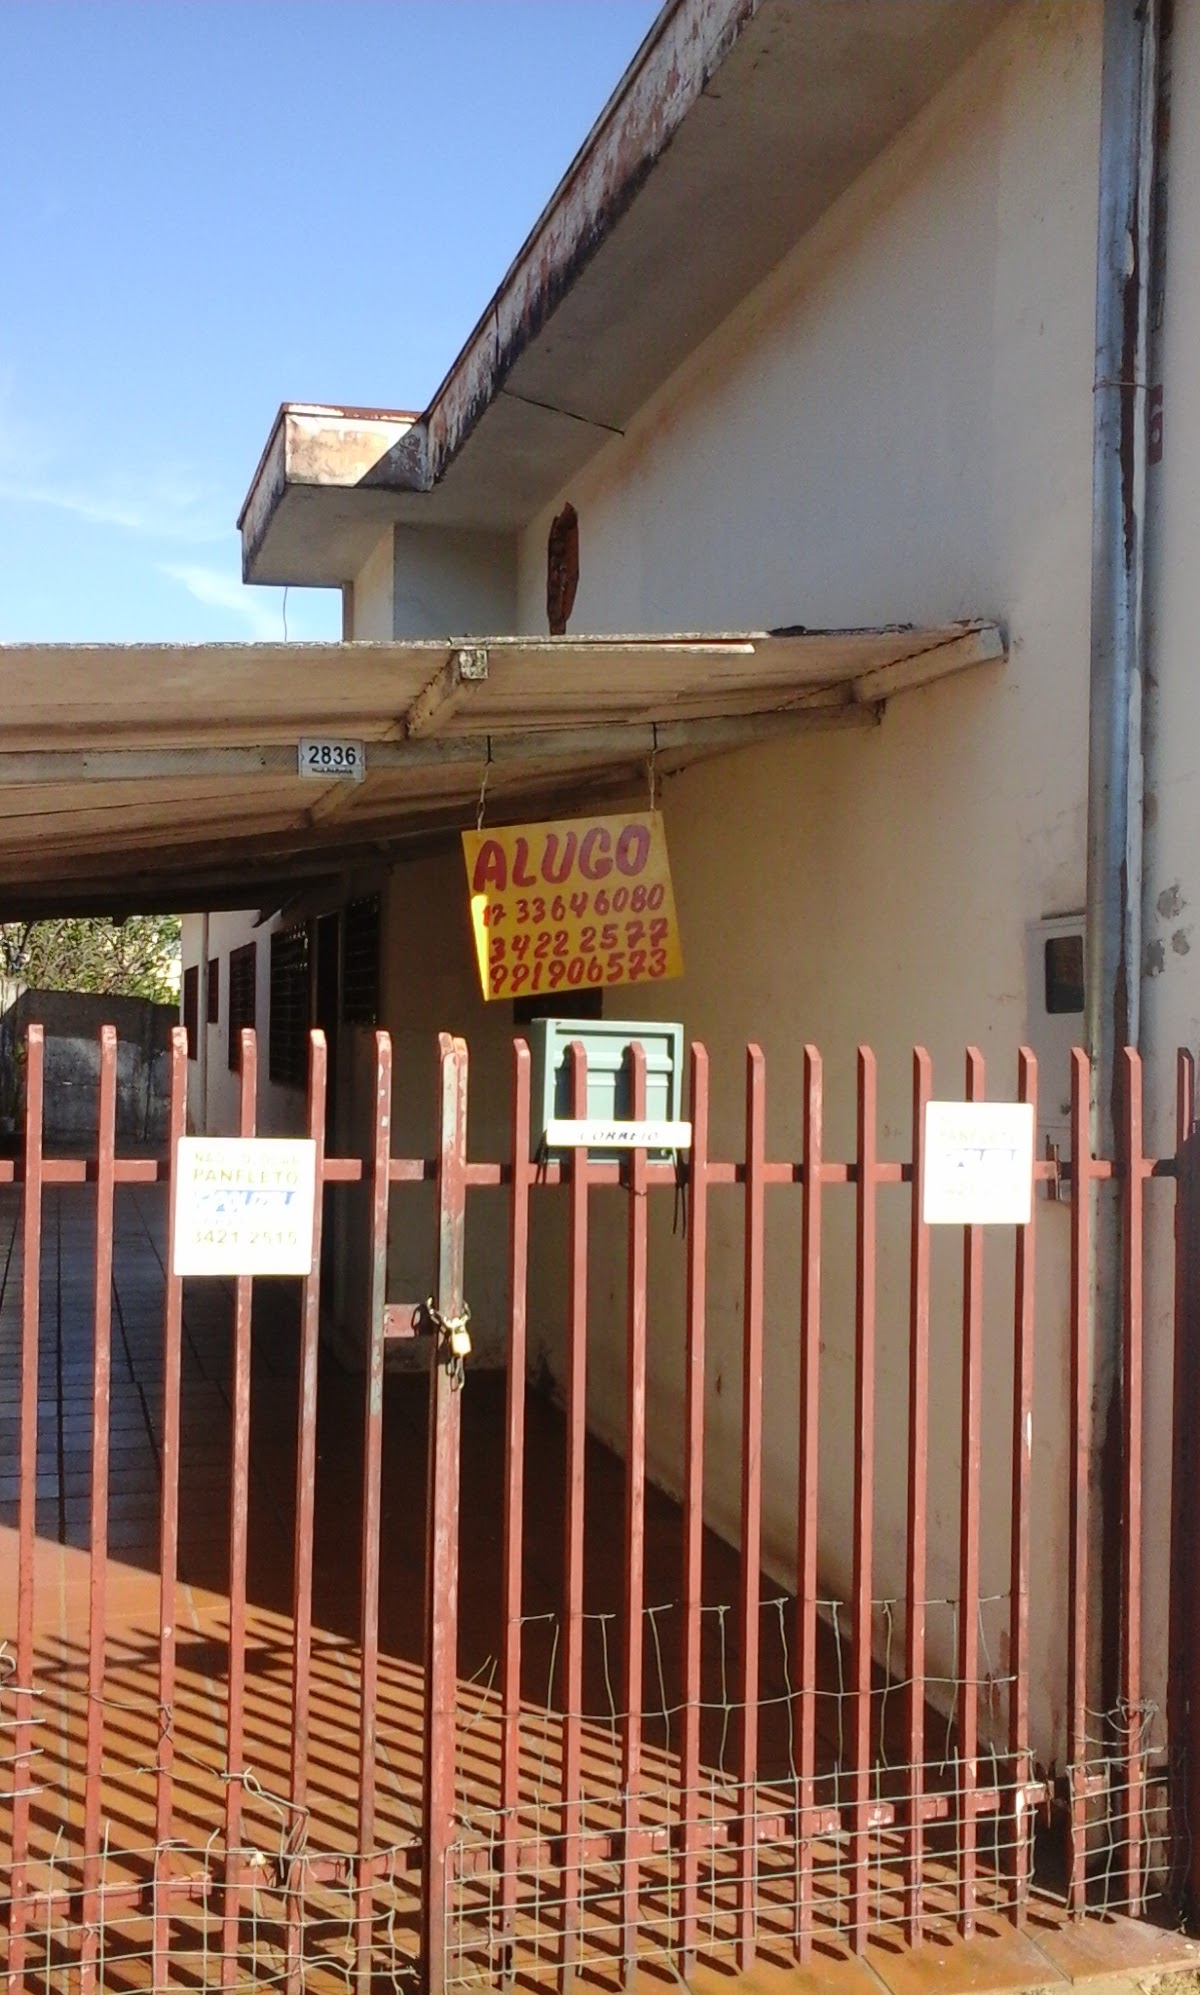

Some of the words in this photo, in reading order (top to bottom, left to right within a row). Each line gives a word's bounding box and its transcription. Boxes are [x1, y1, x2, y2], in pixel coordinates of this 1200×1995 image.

[309, 745, 356, 765] 2836
[472, 824, 651, 892] ALUGO
[490, 949, 667, 995] 991906573
[193, 1168, 298, 1185] PANFLETO
